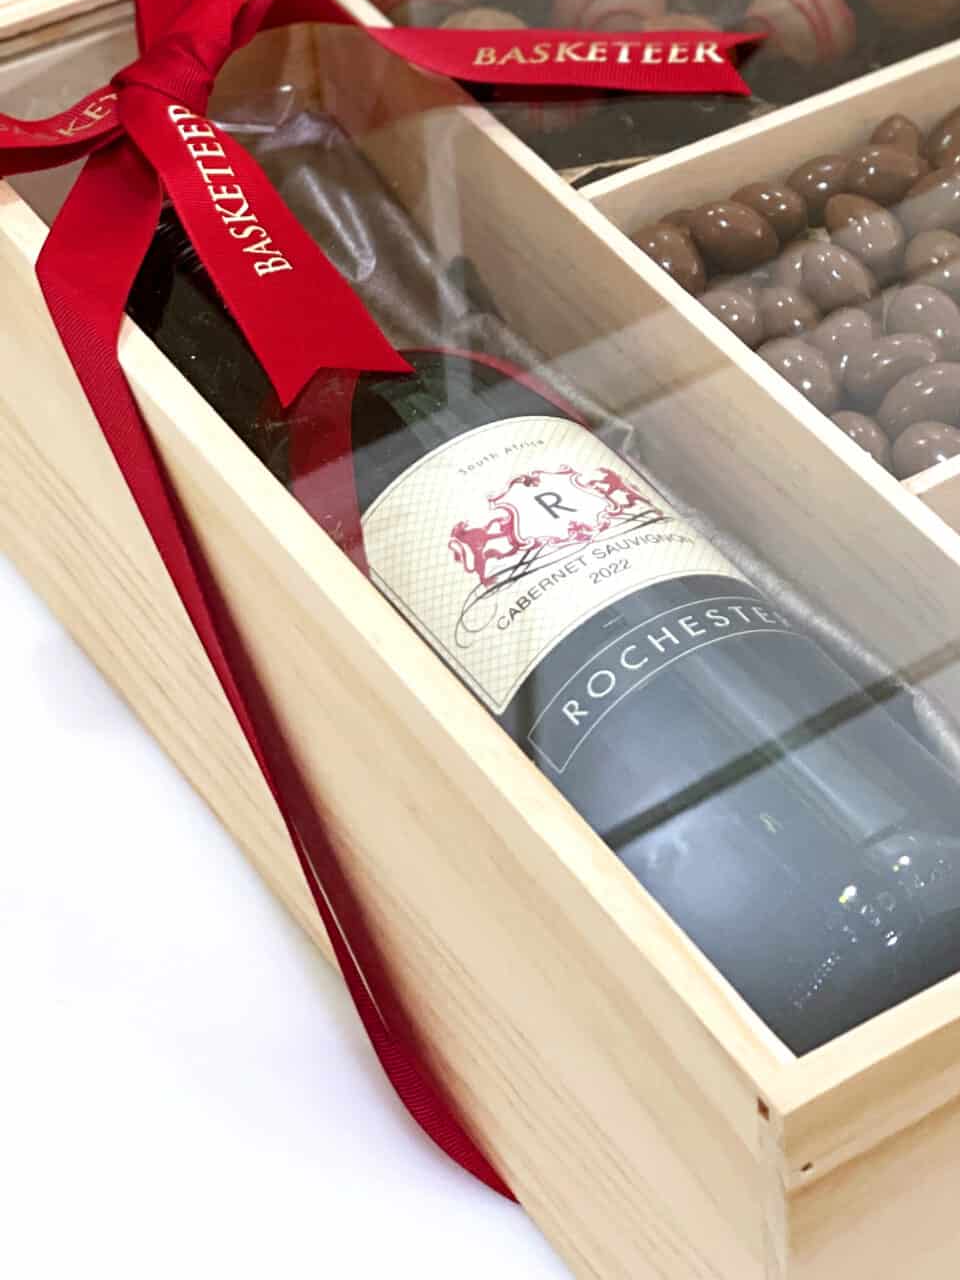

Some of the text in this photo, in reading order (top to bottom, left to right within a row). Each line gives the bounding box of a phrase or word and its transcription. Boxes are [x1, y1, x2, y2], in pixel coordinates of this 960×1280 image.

[472, 40, 725, 66] BASKETEER
[534, 490, 577, 519] R
[588, 558, 632, 585] 2022
[496, 554, 589, 631] CABERNET
